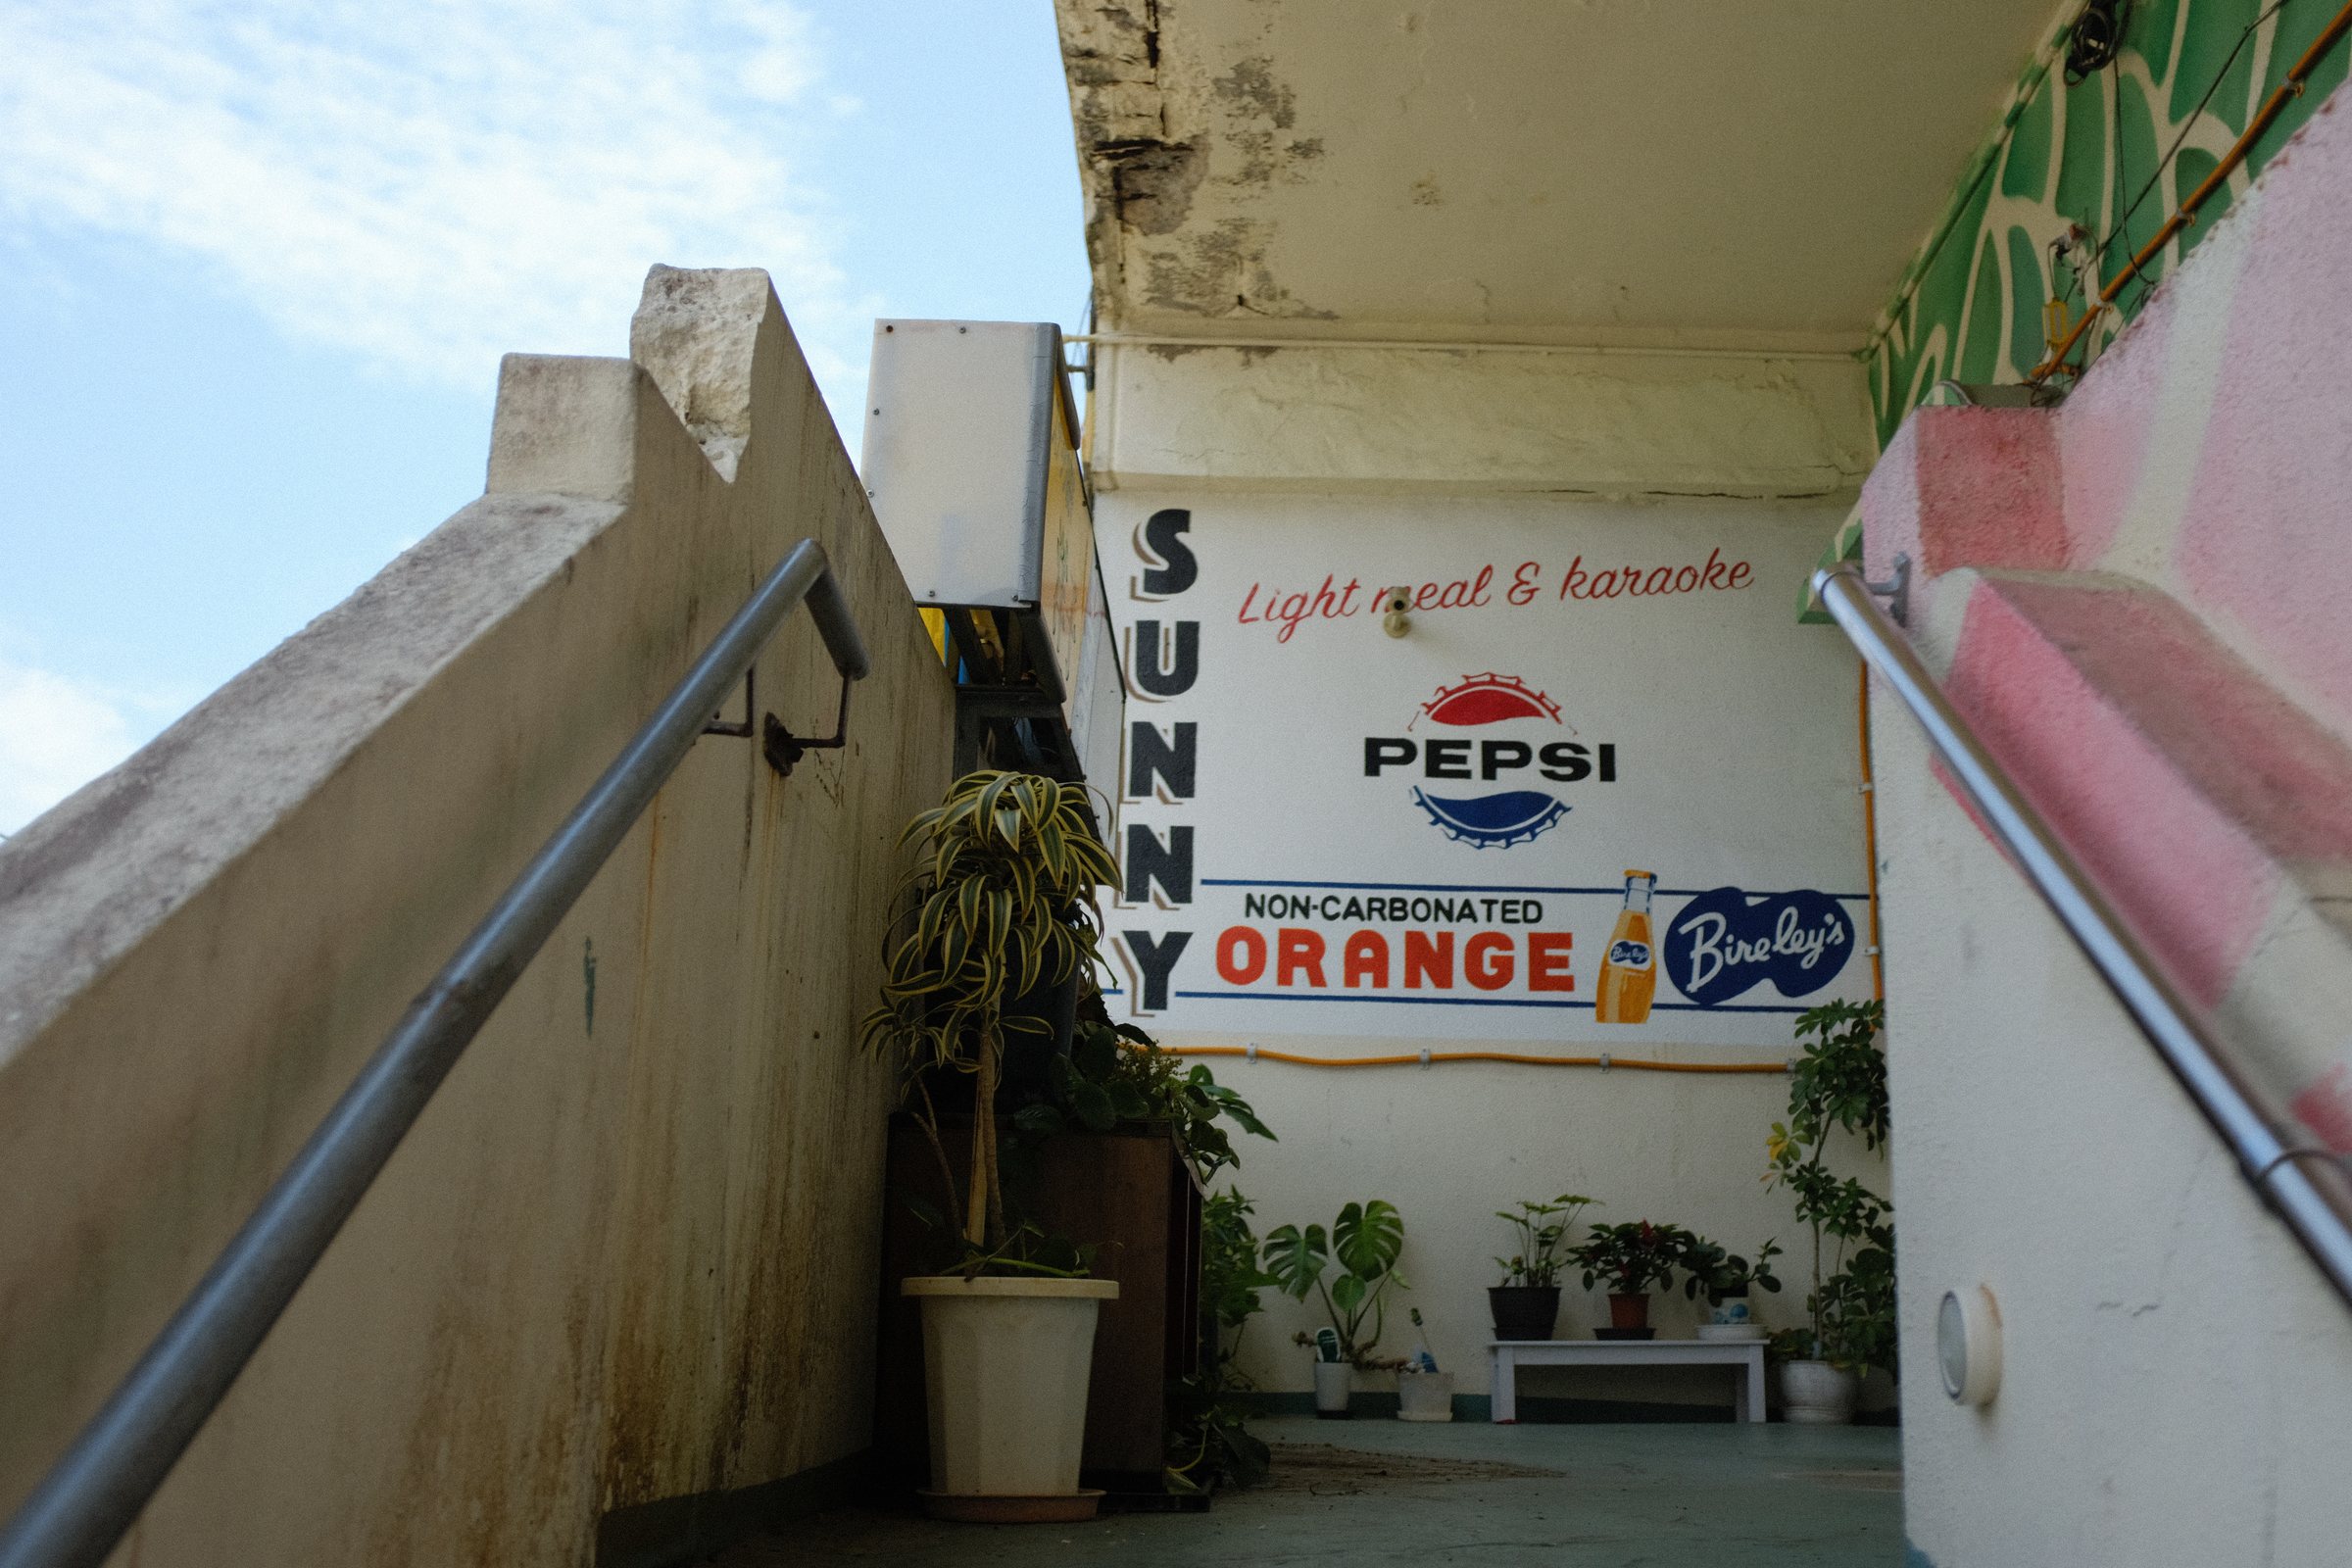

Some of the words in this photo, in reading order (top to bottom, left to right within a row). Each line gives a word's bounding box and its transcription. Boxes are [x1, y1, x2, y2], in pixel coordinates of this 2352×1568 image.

[1239, 573, 1361, 644] Light
[1507, 562, 1541, 606] &
[1560, 547, 1755, 601] karaoke
[1121, 508, 1200, 1011] SUNNY
[1364, 737, 1616, 782] PEPSI
[1245, 893, 1544, 924] NON-CARBONATED
[1215, 925, 1576, 993] ORANGE
[1678, 906, 1845, 994] Bireley's
